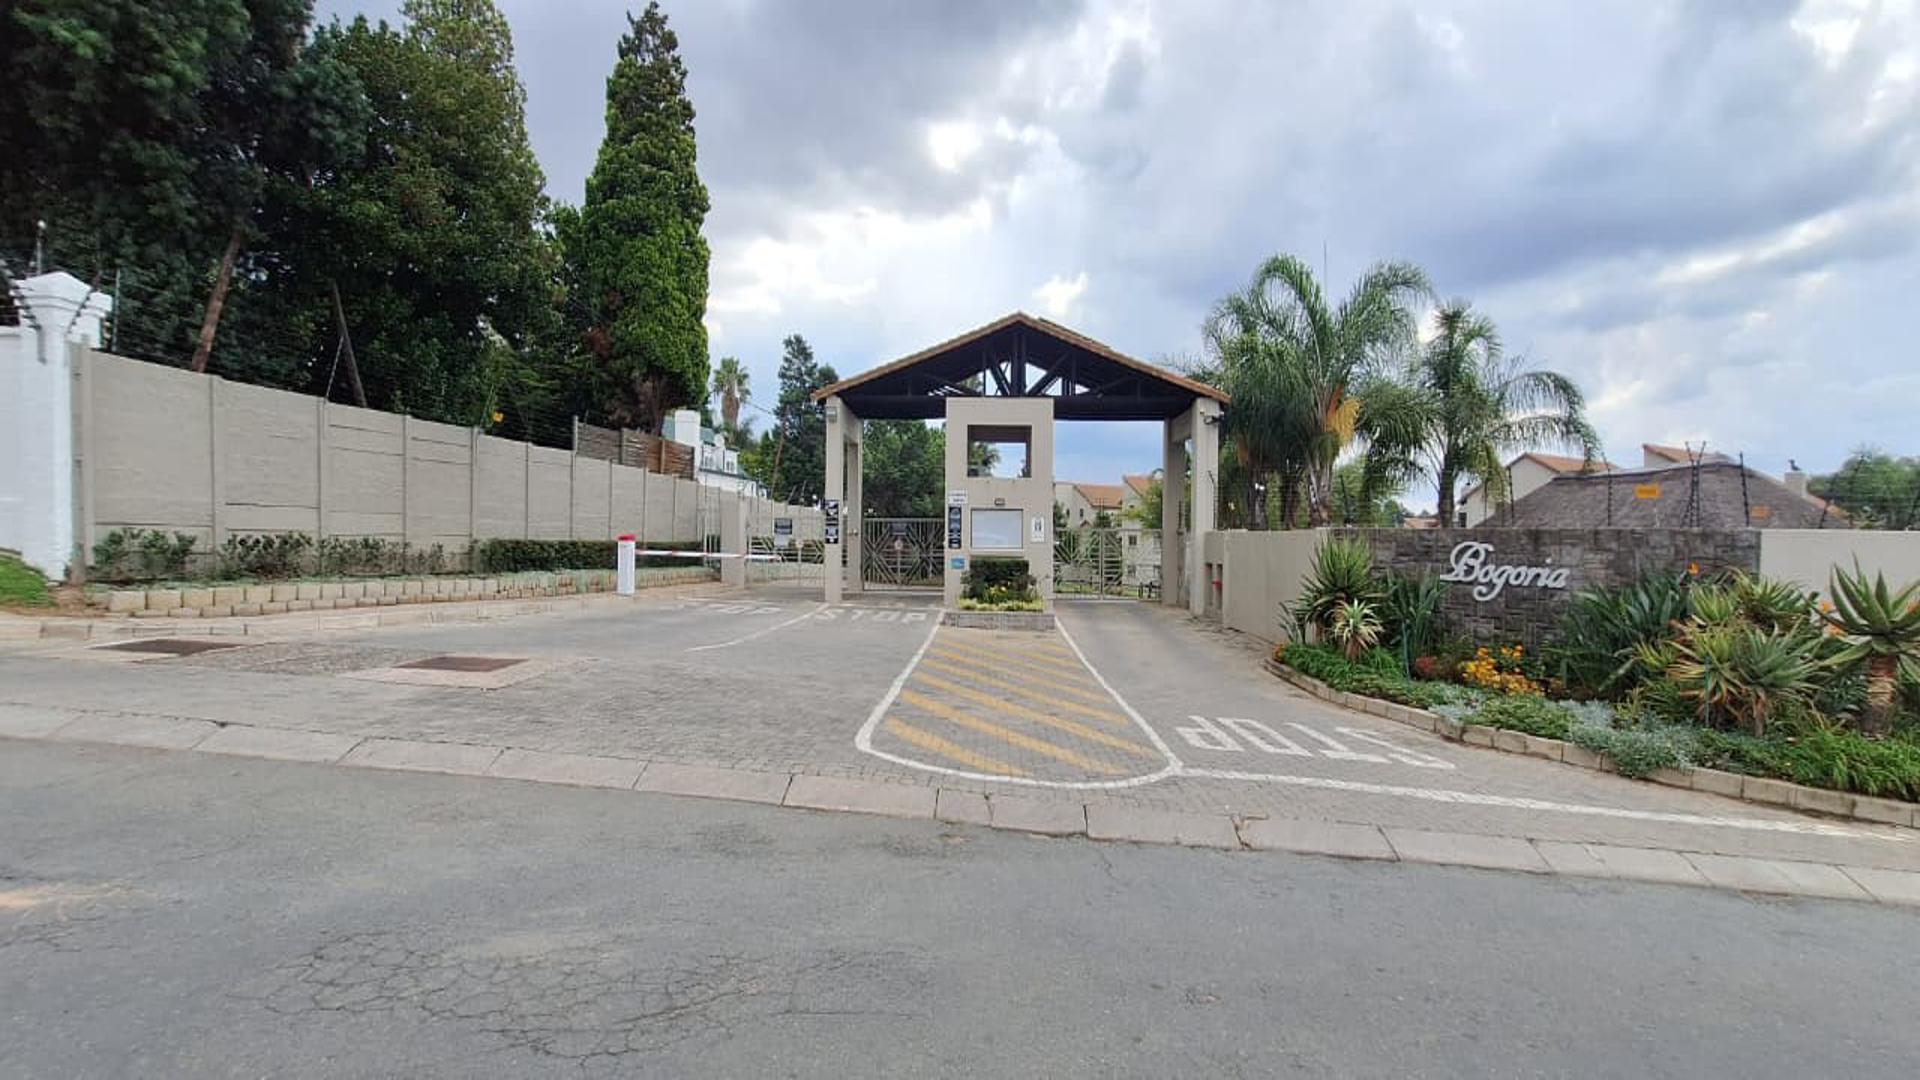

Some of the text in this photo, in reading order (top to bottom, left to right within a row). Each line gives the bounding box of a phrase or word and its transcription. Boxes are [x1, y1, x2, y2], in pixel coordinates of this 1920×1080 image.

[1440, 541, 1571, 601] Bogoria
[814, 608, 928, 623] STOP
[1175, 715, 1456, 769] STOP
